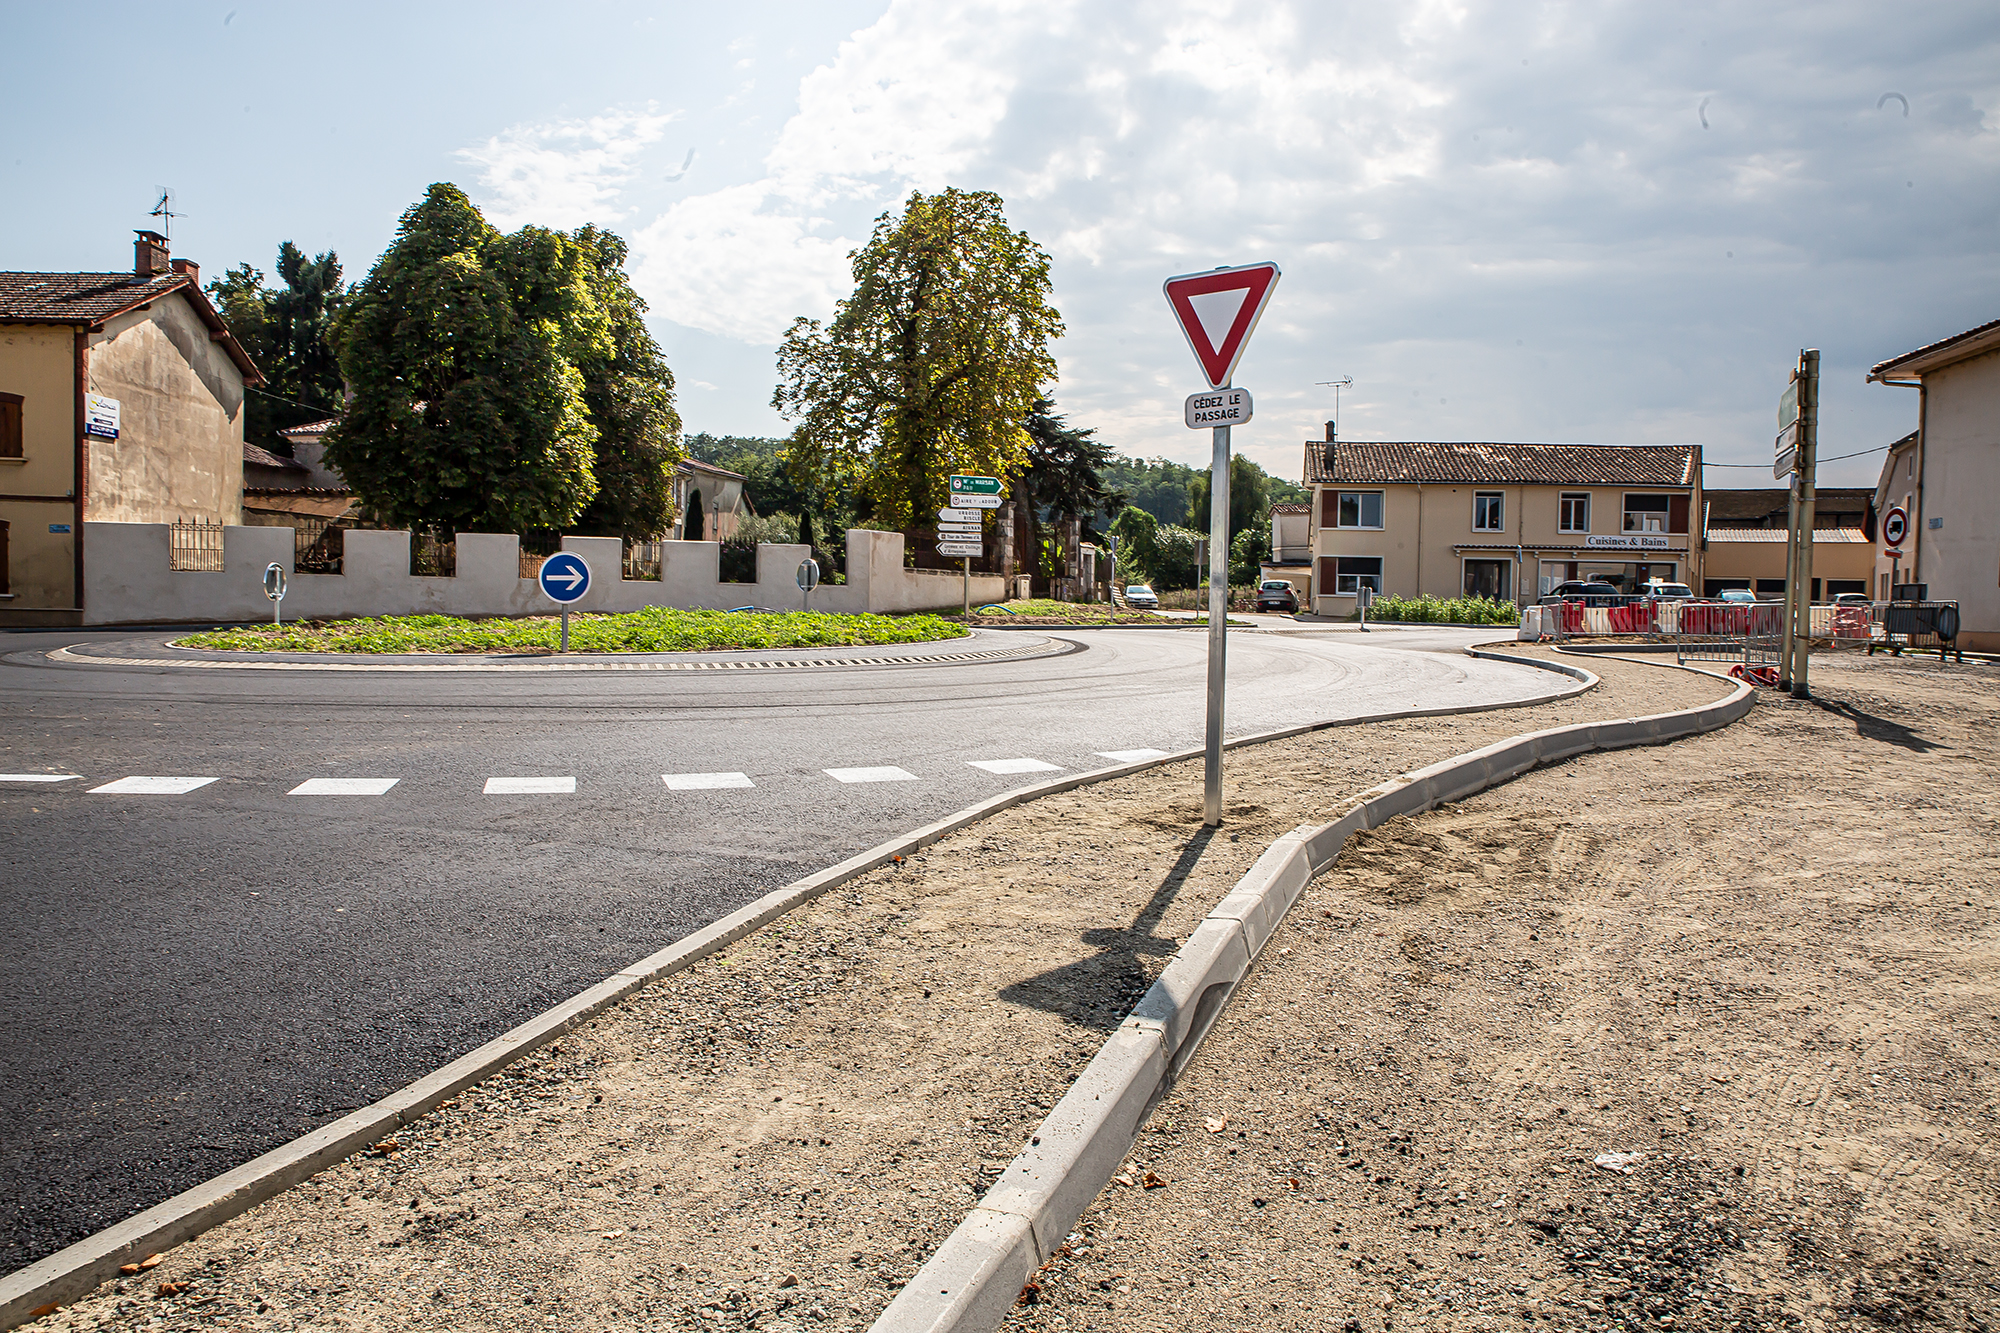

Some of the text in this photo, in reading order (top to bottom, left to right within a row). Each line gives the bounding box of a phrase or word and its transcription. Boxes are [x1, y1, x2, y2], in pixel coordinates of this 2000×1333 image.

[1193, 394, 1241, 409] CÉDEZ LE
[1194, 408, 1239, 423] PASSAGE
[1587, 536, 1667, 546] Cuisines & Bains
